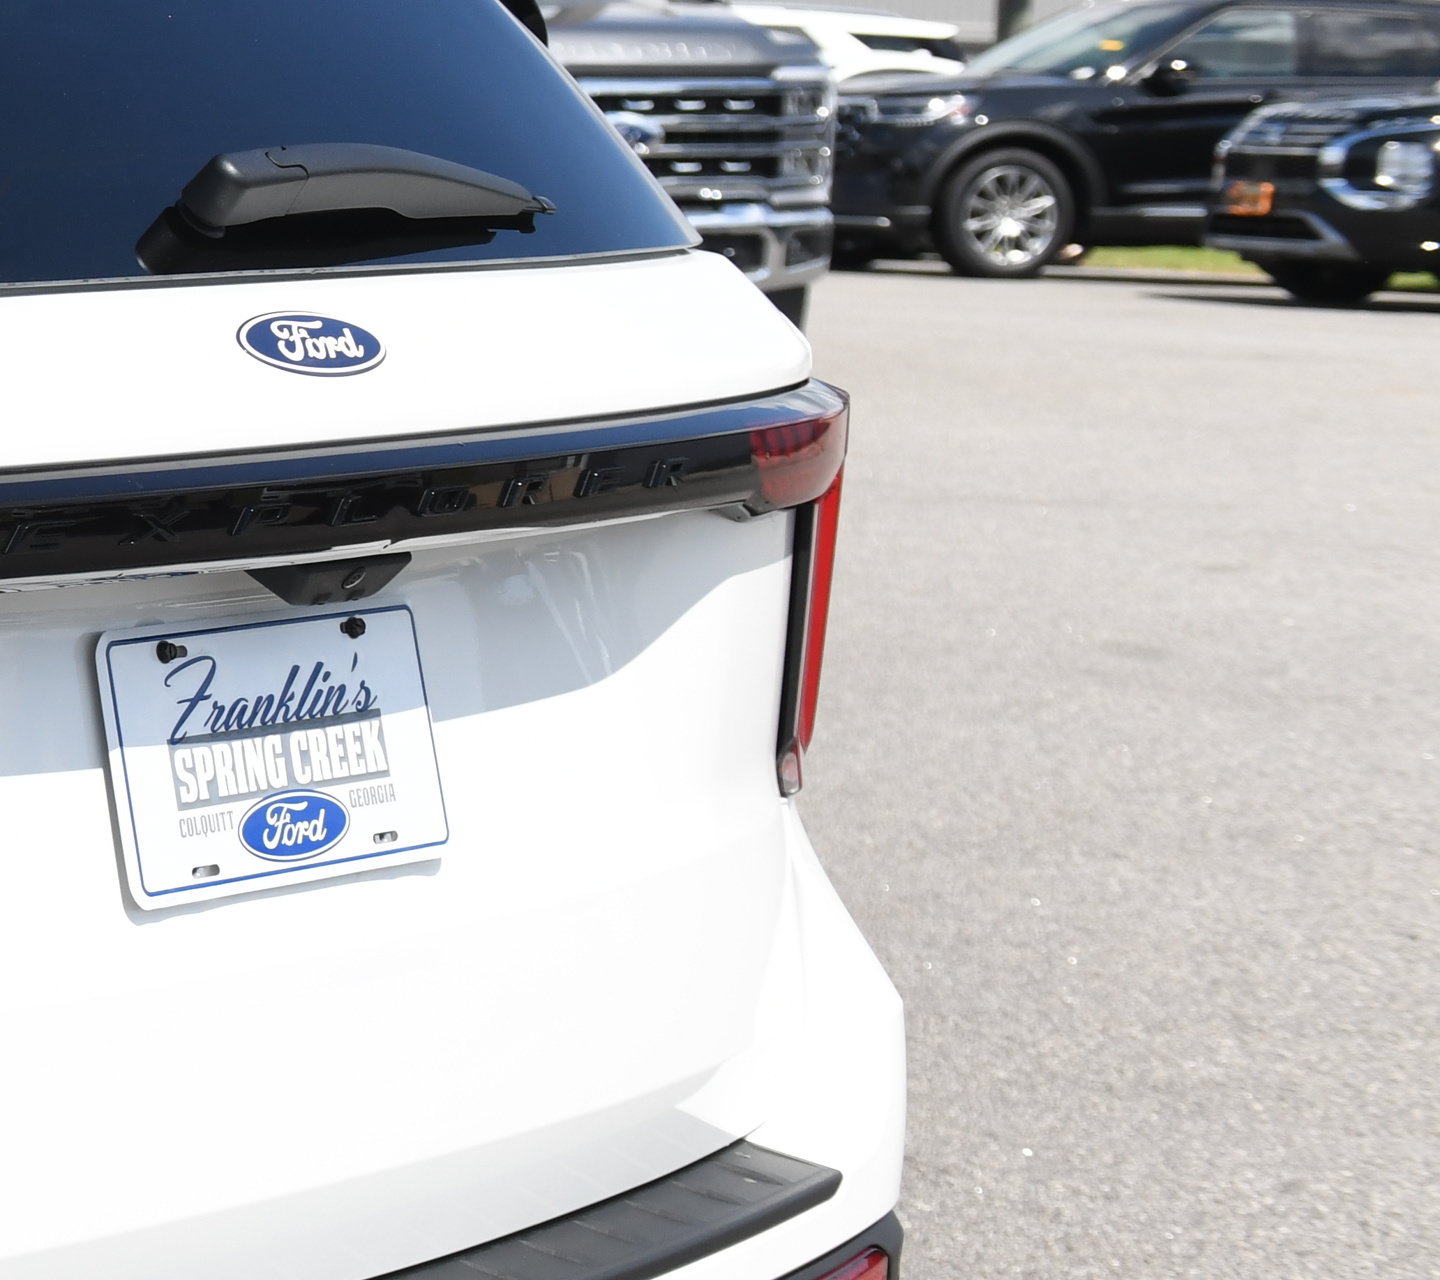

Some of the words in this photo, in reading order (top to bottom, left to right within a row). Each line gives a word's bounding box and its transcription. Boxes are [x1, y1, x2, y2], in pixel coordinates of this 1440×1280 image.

[269, 319, 365, 362] Ford
[1, 456, 690, 555] EXPLORER
[163, 650, 378, 746] Franklin's
[174, 734, 288, 803] SPRING
[290, 719, 389, 785] CREEK
[348, 782, 397, 808] GEORGIA
[178, 810, 235, 839] COLQUITT
[263, 801, 327, 849] Ford
